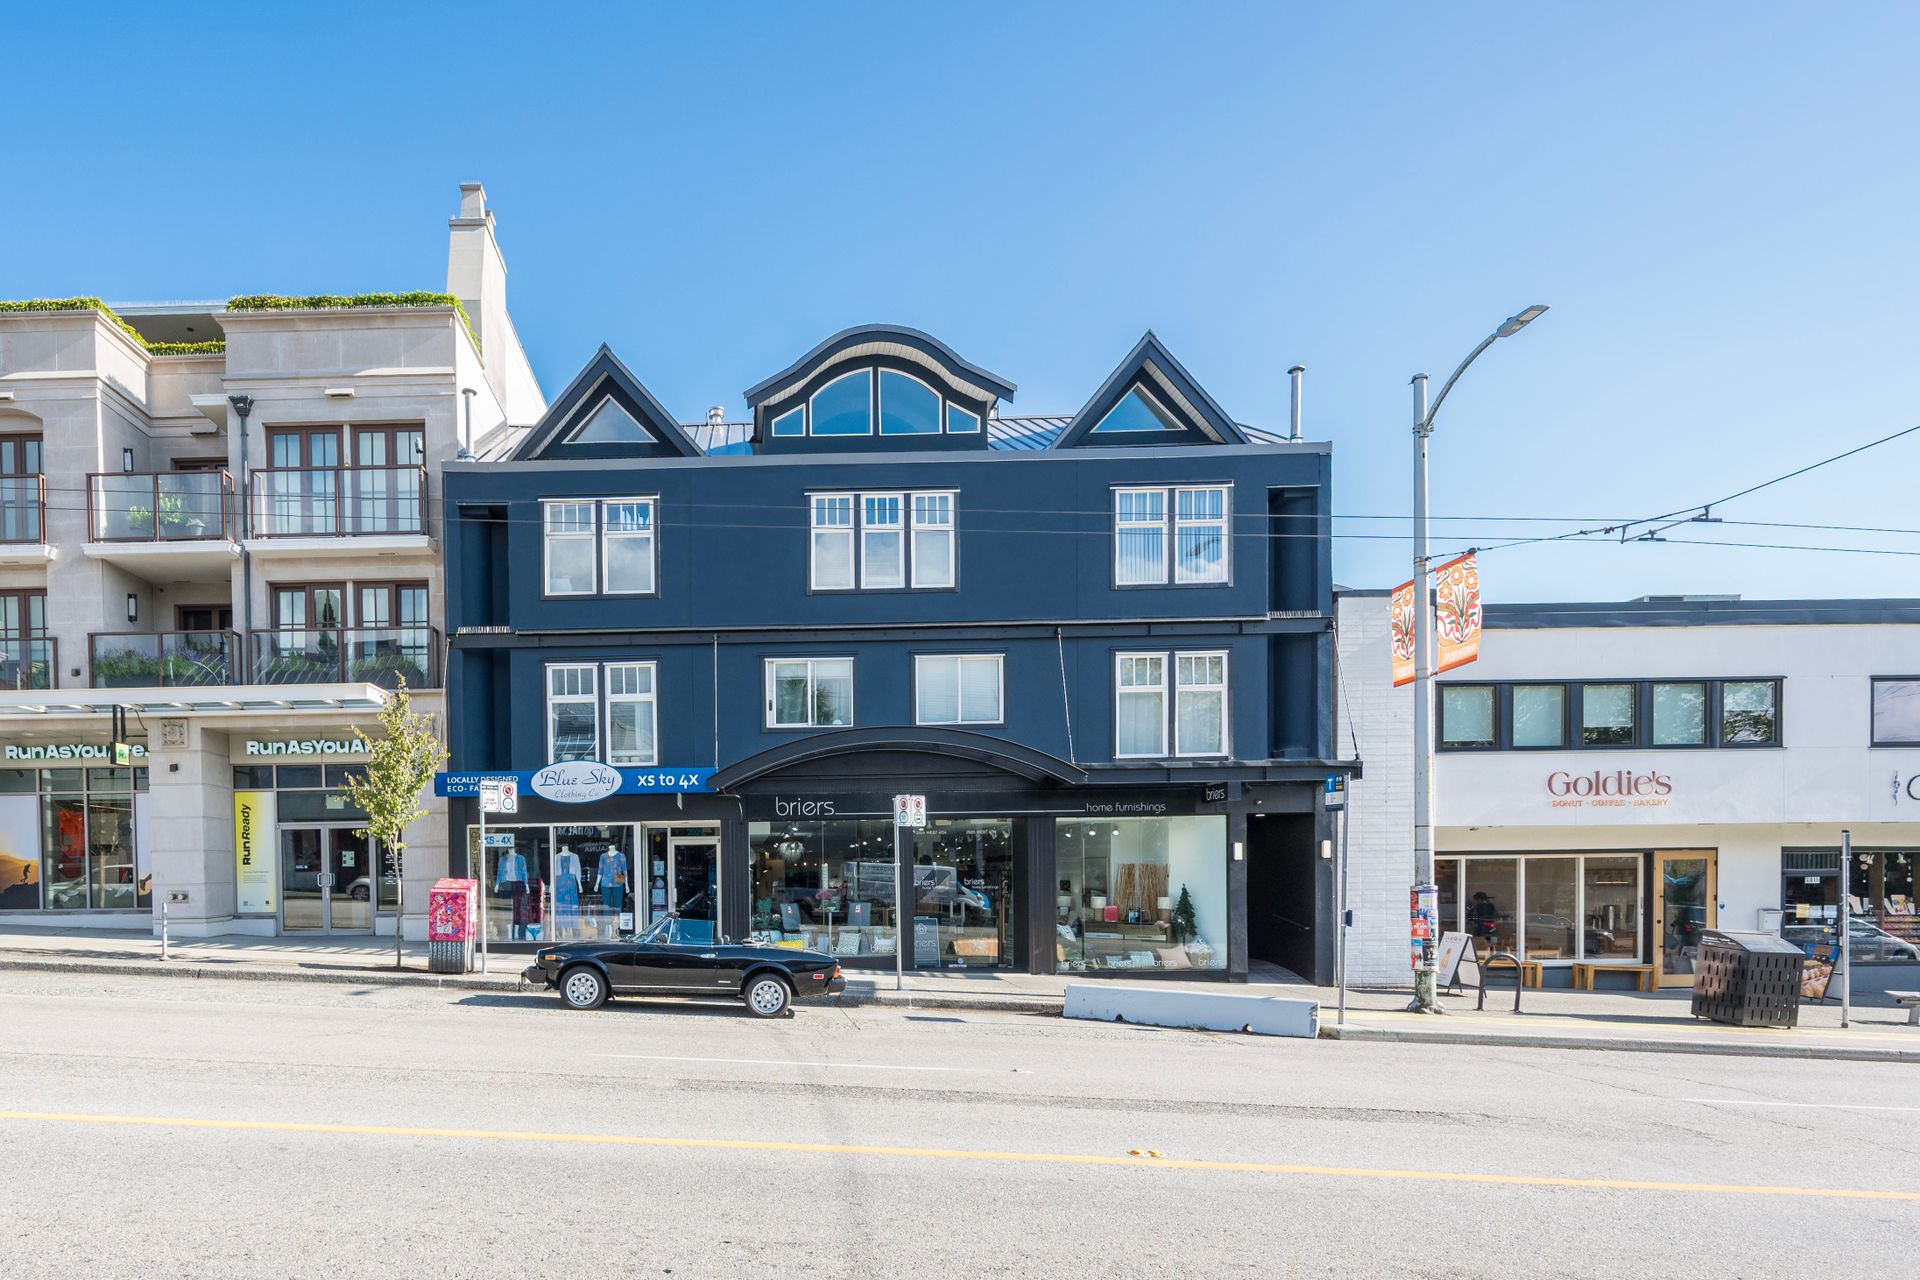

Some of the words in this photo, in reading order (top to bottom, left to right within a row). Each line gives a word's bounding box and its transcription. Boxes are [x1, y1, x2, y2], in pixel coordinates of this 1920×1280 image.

[5, 744, 149, 759] RunAsYoue.
[447, 776, 479, 784] LOCALLY
[480, 775, 519, 783] DESIGNED
[540, 770, 578, 787] Blue
[582, 768, 616, 791] Sky
[659, 773, 675, 786] to
[1547, 770, 1673, 797] Goldie's
[554, 787, 586, 799] Clothing
[1205, 787, 1226, 801] briers
[775, 796, 836, 816] briers
[1086, 802, 1113, 812] home
[1115, 802, 1167, 814] furnishings
[1591, 799, 1626, 807] COFFEE
[500, 835, 512, 844] 4X
[964, 877, 985, 886] briers
[1061, 959, 1087, 968] briers
[1107, 959, 1132, 968] briers
